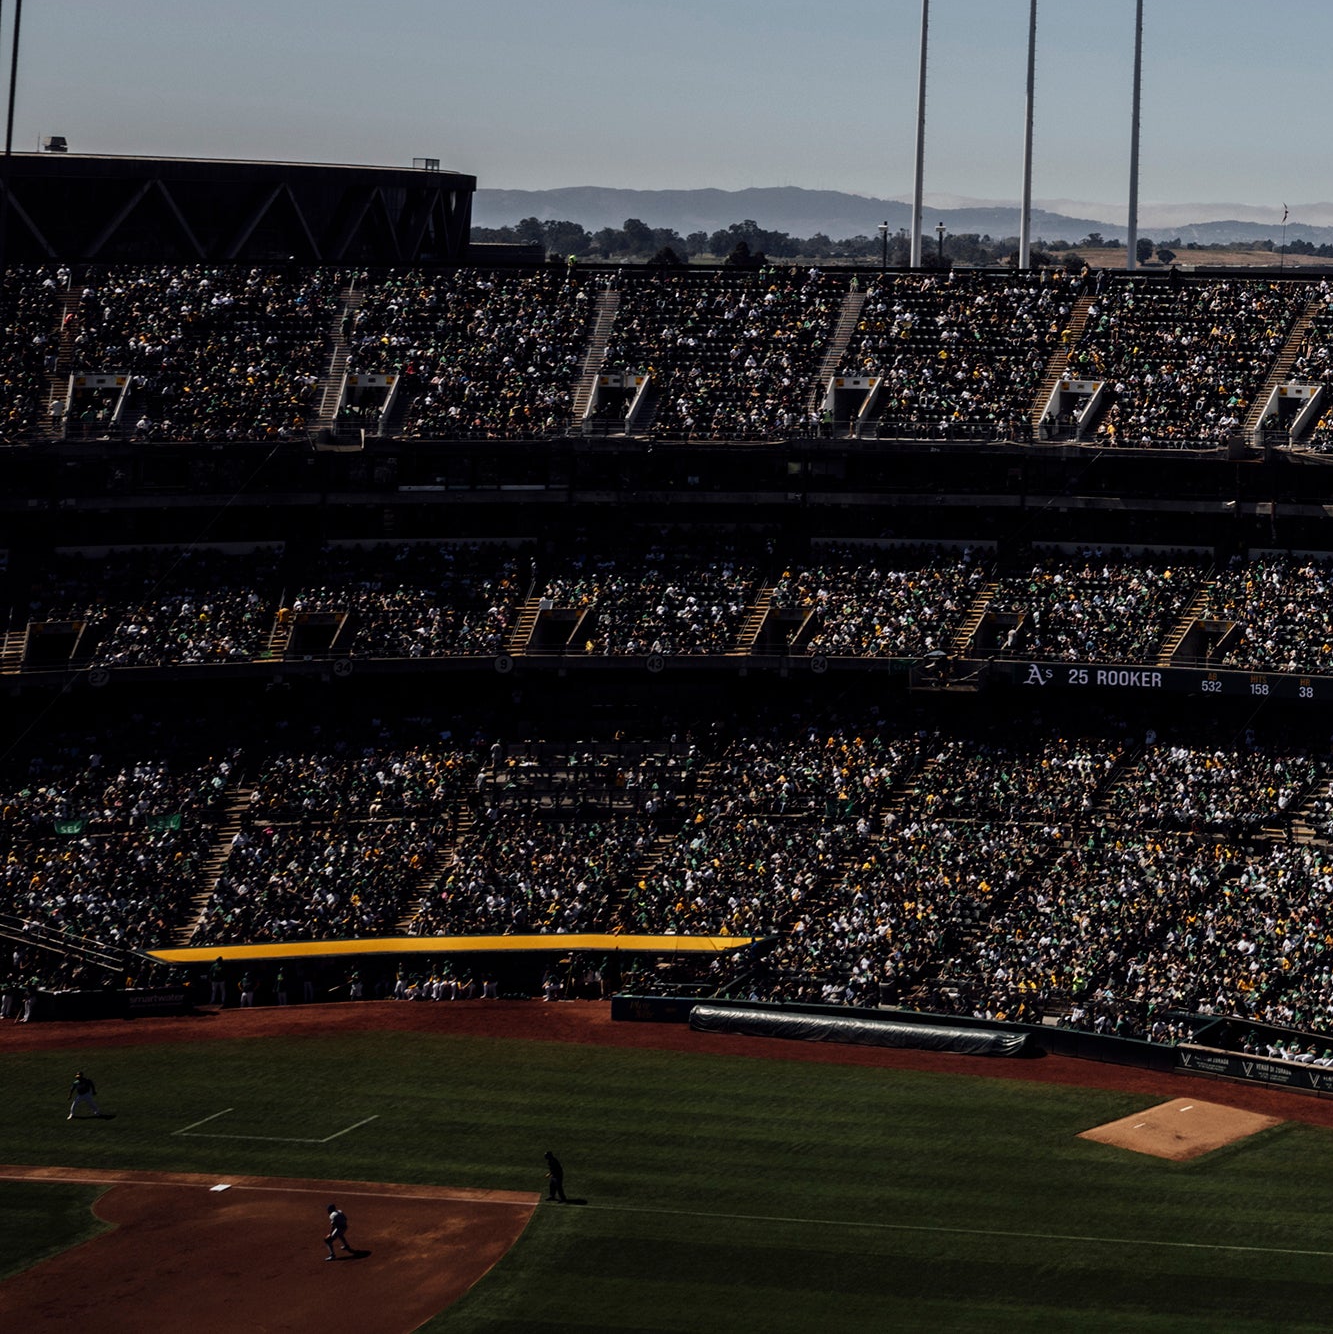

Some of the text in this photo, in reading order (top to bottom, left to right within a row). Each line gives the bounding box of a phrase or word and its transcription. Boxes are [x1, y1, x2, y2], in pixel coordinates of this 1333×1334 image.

[1068, 669, 1088, 685] 25
[1097, 670, 1162, 687] ROOKER
[1201, 680, 1222, 693] 532
[1250, 684, 1269, 696] 158
[1299, 686, 1314, 698] 38
